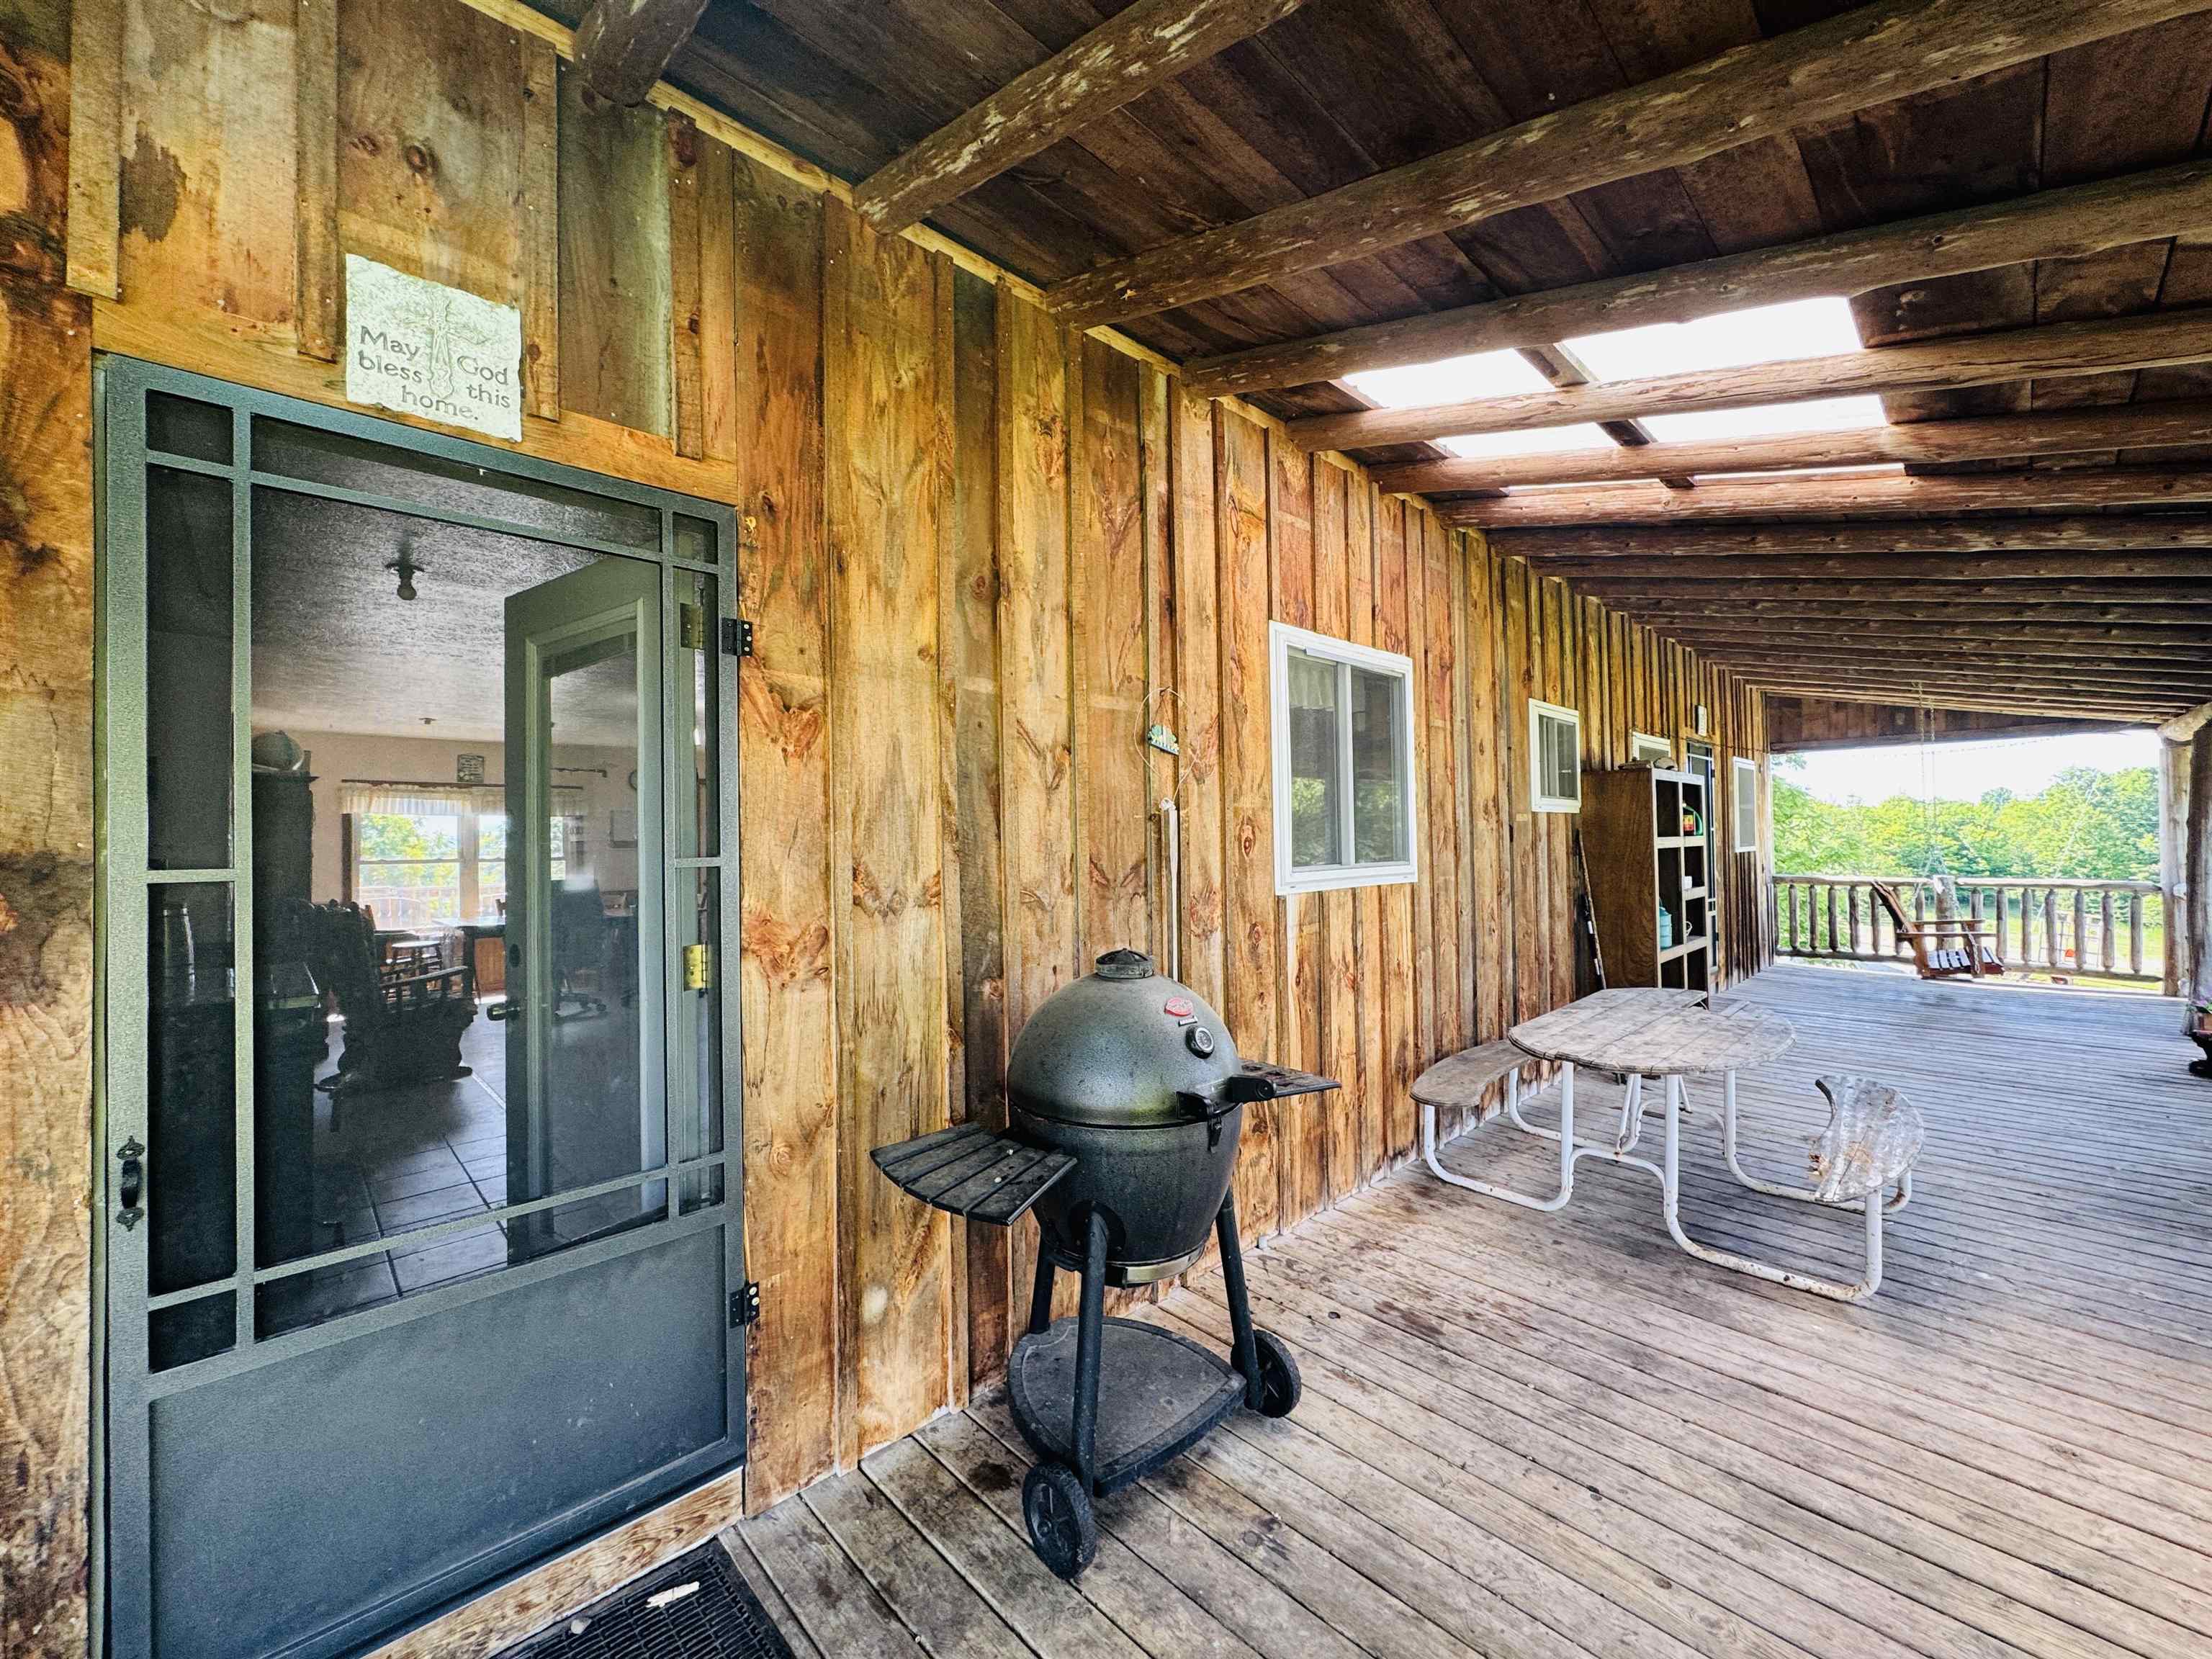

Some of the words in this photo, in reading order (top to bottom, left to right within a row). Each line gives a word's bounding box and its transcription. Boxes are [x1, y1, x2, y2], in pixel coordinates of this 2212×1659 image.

[358, 350, 422, 383] bless
[467, 384, 511, 408] this
[361, 325, 421, 361] May
[457, 356, 508, 385] God
[402, 385, 478, 421] home.
